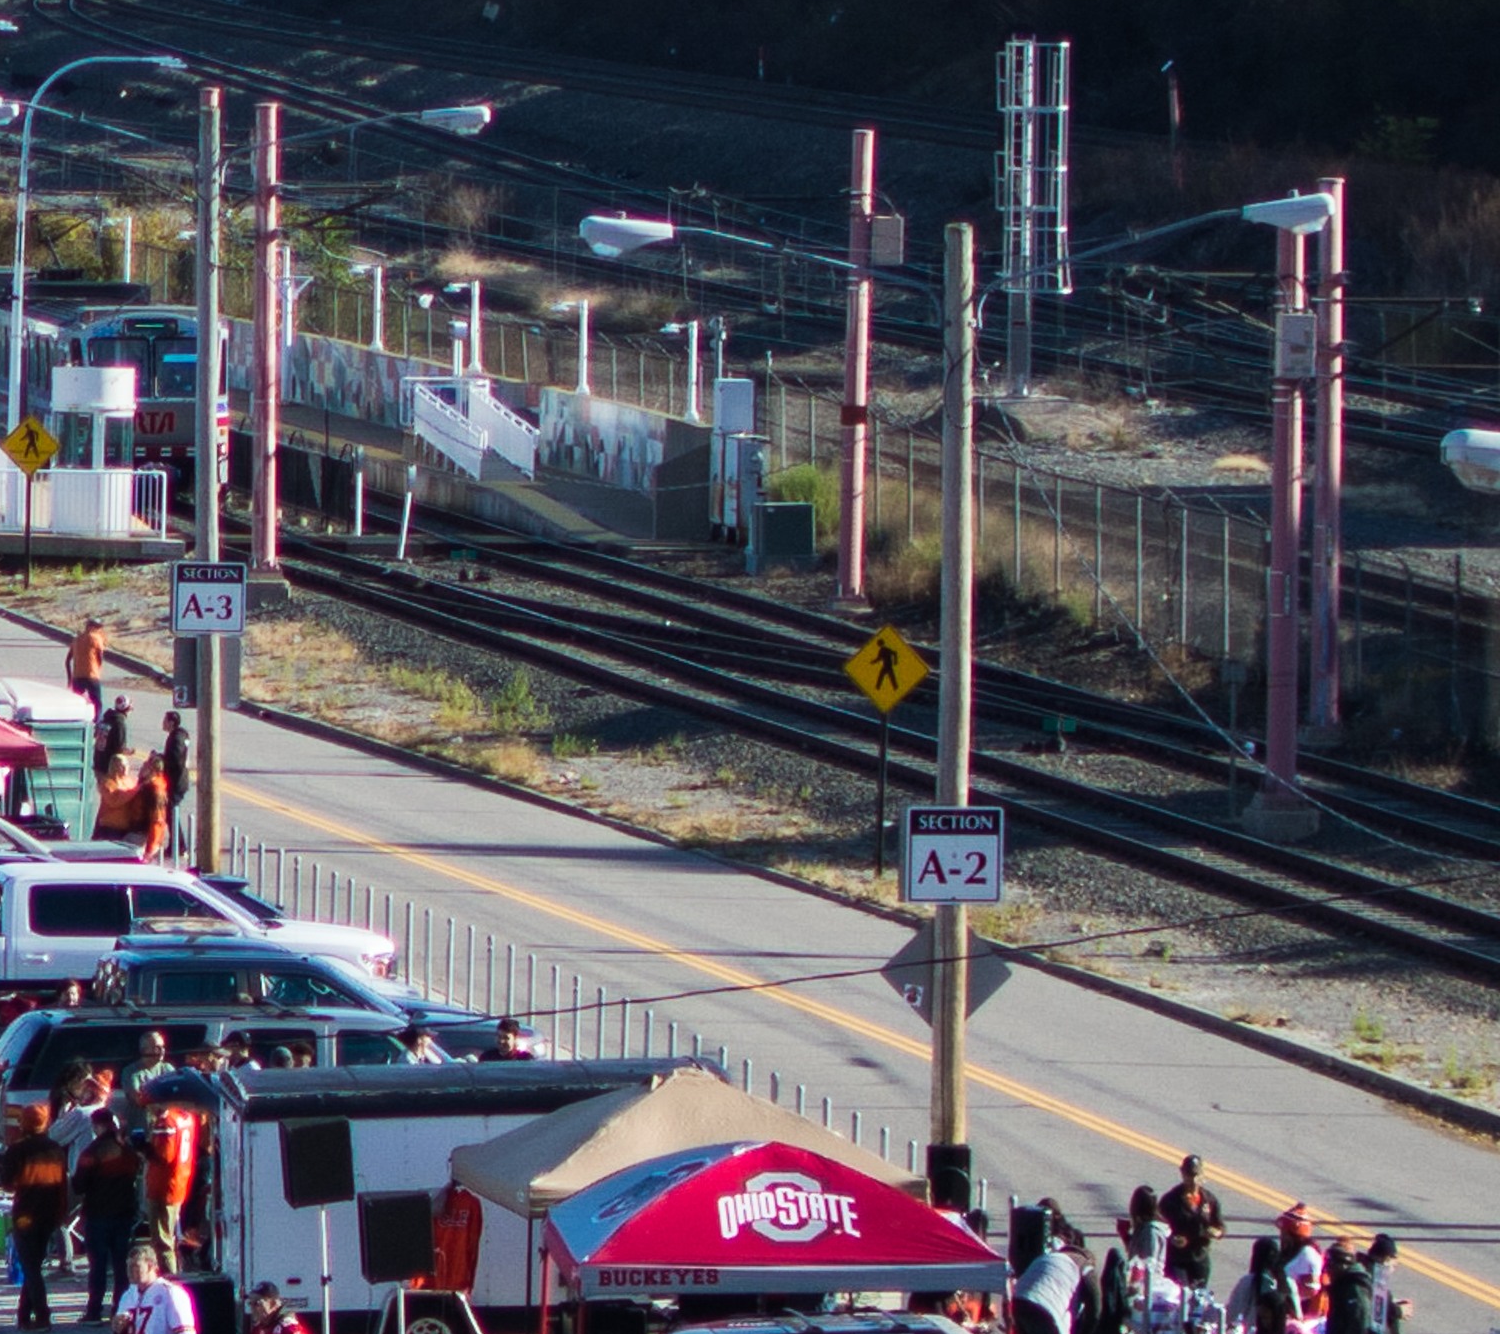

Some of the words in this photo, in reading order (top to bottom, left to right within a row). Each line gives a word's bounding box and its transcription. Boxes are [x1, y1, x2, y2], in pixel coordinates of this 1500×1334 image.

[182, 567, 239, 580] SECTION
[181, 592, 234, 621] A-3
[918, 814, 994, 830] SECTION
[917, 848, 988, 885] A-2
[717, 1191, 782, 1240] OHIO
[776, 1186, 862, 1239] STATE
[599, 1267, 720, 1288] BUCKEYES
